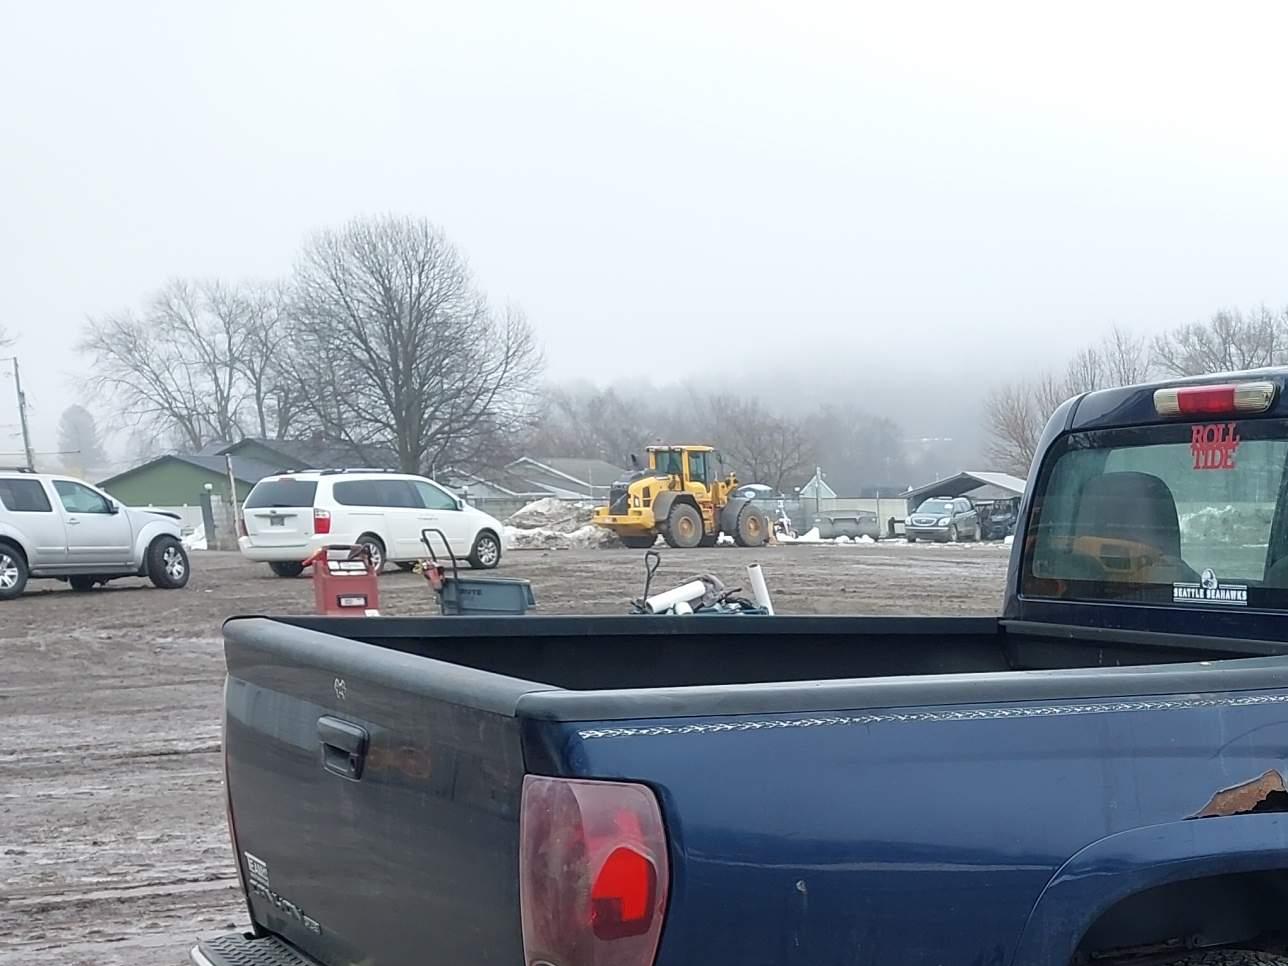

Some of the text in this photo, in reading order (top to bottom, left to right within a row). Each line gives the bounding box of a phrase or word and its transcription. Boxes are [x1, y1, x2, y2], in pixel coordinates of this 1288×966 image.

[1191, 422, 1241, 448] ROLL
[1192, 446, 1237, 470] TIDE
[1173, 587, 1248, 601] SEATTLE SEAHAWKS
